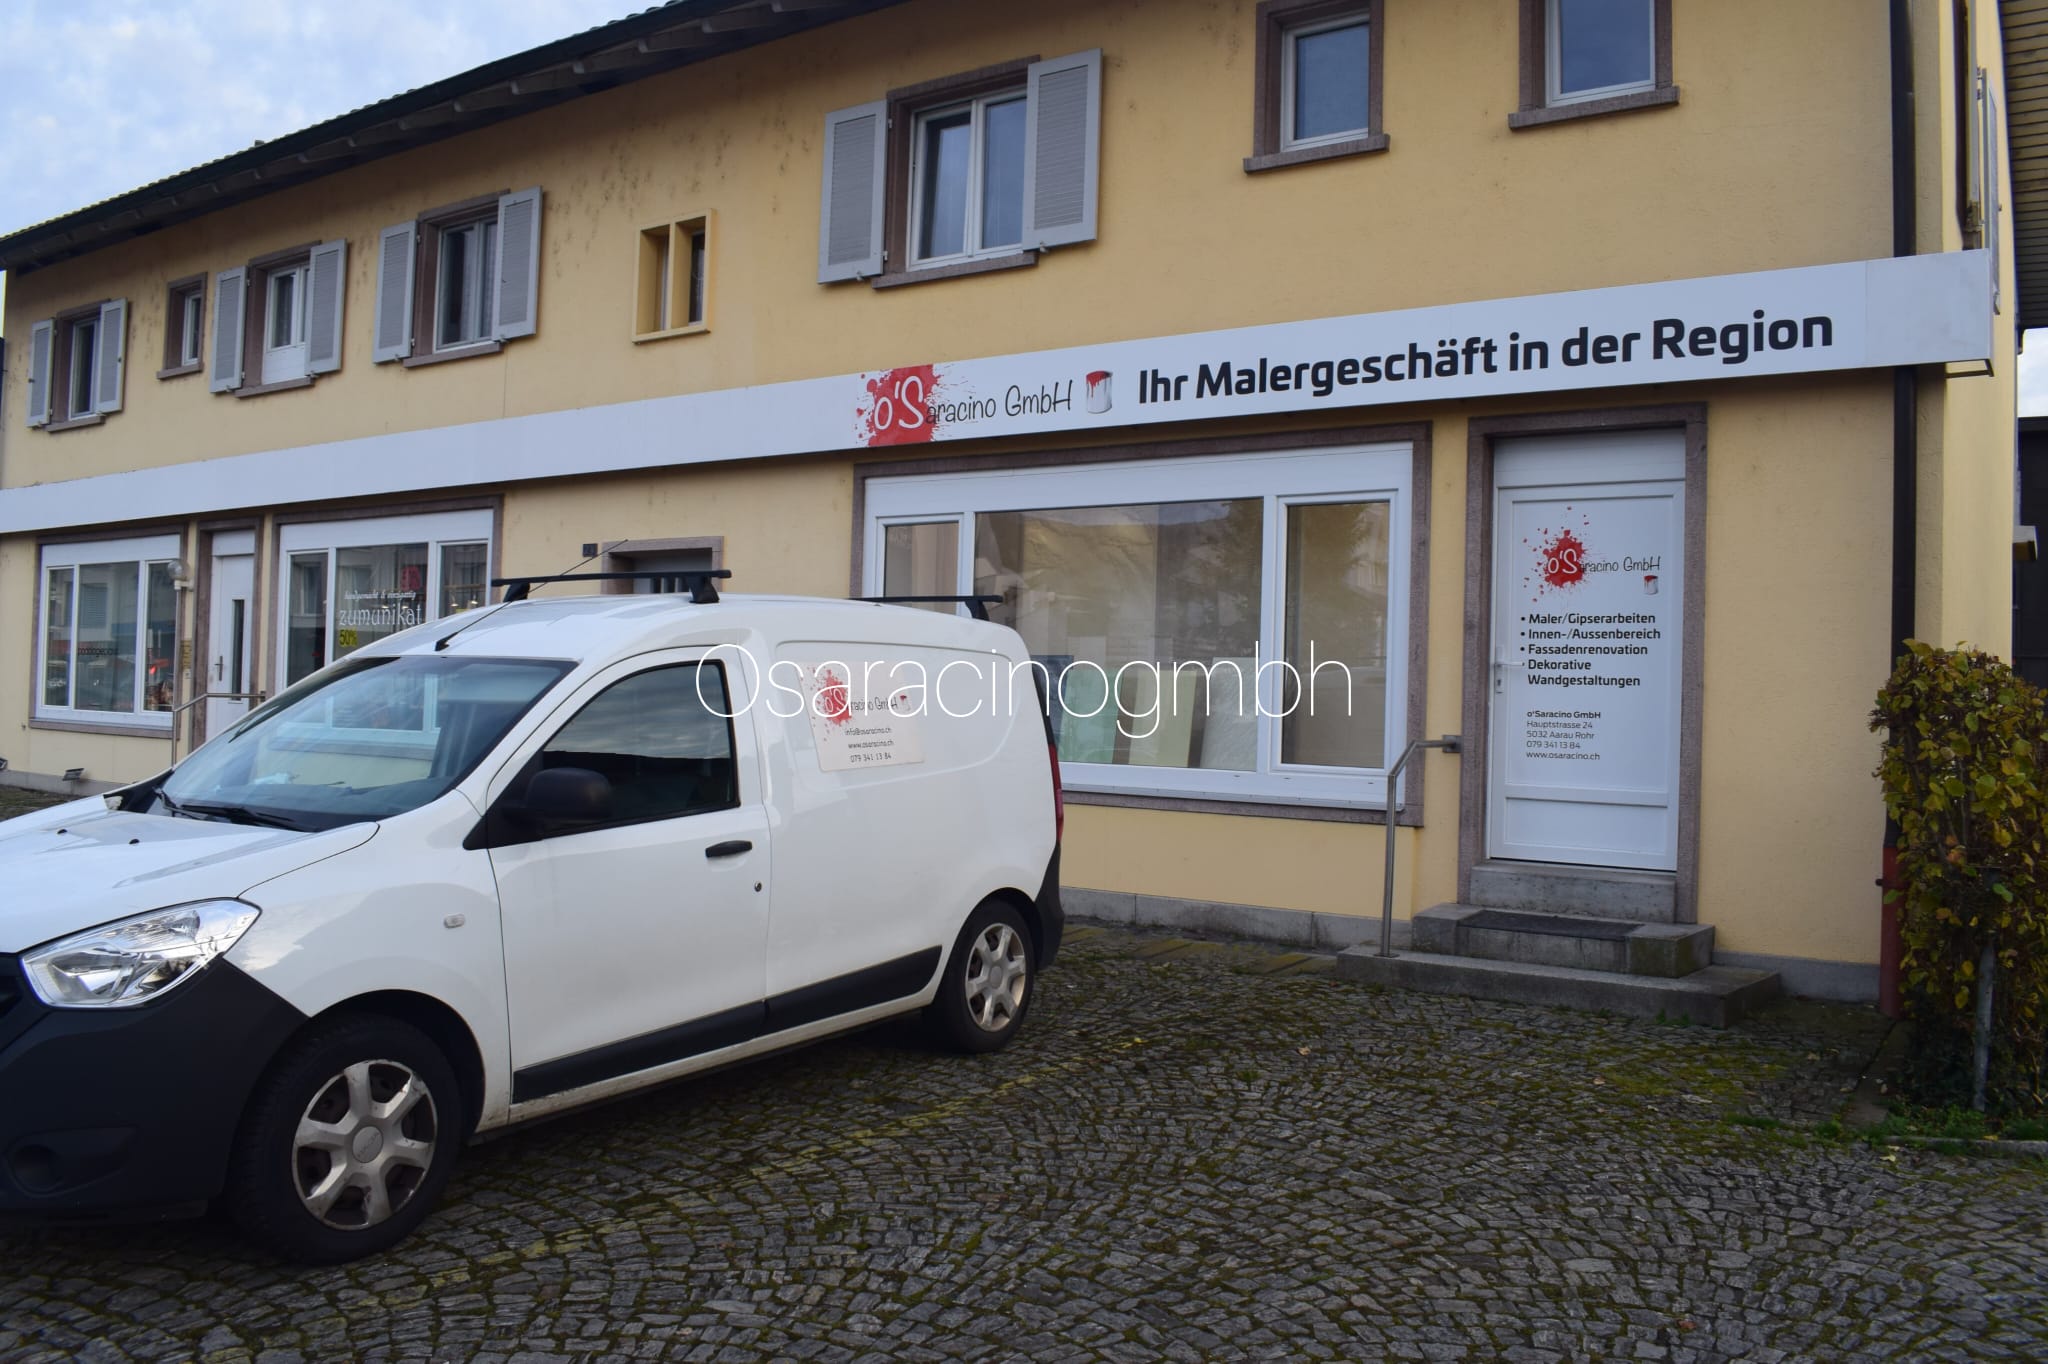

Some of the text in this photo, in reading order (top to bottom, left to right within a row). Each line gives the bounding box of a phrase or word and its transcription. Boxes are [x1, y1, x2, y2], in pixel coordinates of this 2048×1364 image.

[1004, 379, 1073, 417] GmbH
[1139, 369, 1188, 404] Ihr
[1196, 337, 1497, 397] Malergeschäft
[1509, 332, 1539, 371] in
[1561, 327, 1641, 367] der
[1653, 309, 1832, 364] Region
[1623, 555, 1661, 572] GmbH
[339, 603, 422, 626] zumunikat
[1528, 613, 1656, 625] Maler/Gipserarbeiten
[1528, 628, 1661, 639] Innen-/Aussenbereich
[1528, 644, 1648, 655] Fassadenrenovation
[1528, 659, 1591, 670] Dekorative
[1528, 674, 1640, 688] Wandgestaltungen
[1573, 711, 1601, 719] GmbH
[1526, 721, 1593, 730] Hauptstrasse 24
[1549, 731, 1573, 739] Aarau
[1575, 731, 1595, 740] Rohr
[1526, 740, 1581, 749] 079 341 13 84
[1526, 751, 1601, 760] www.osaracino.ch
